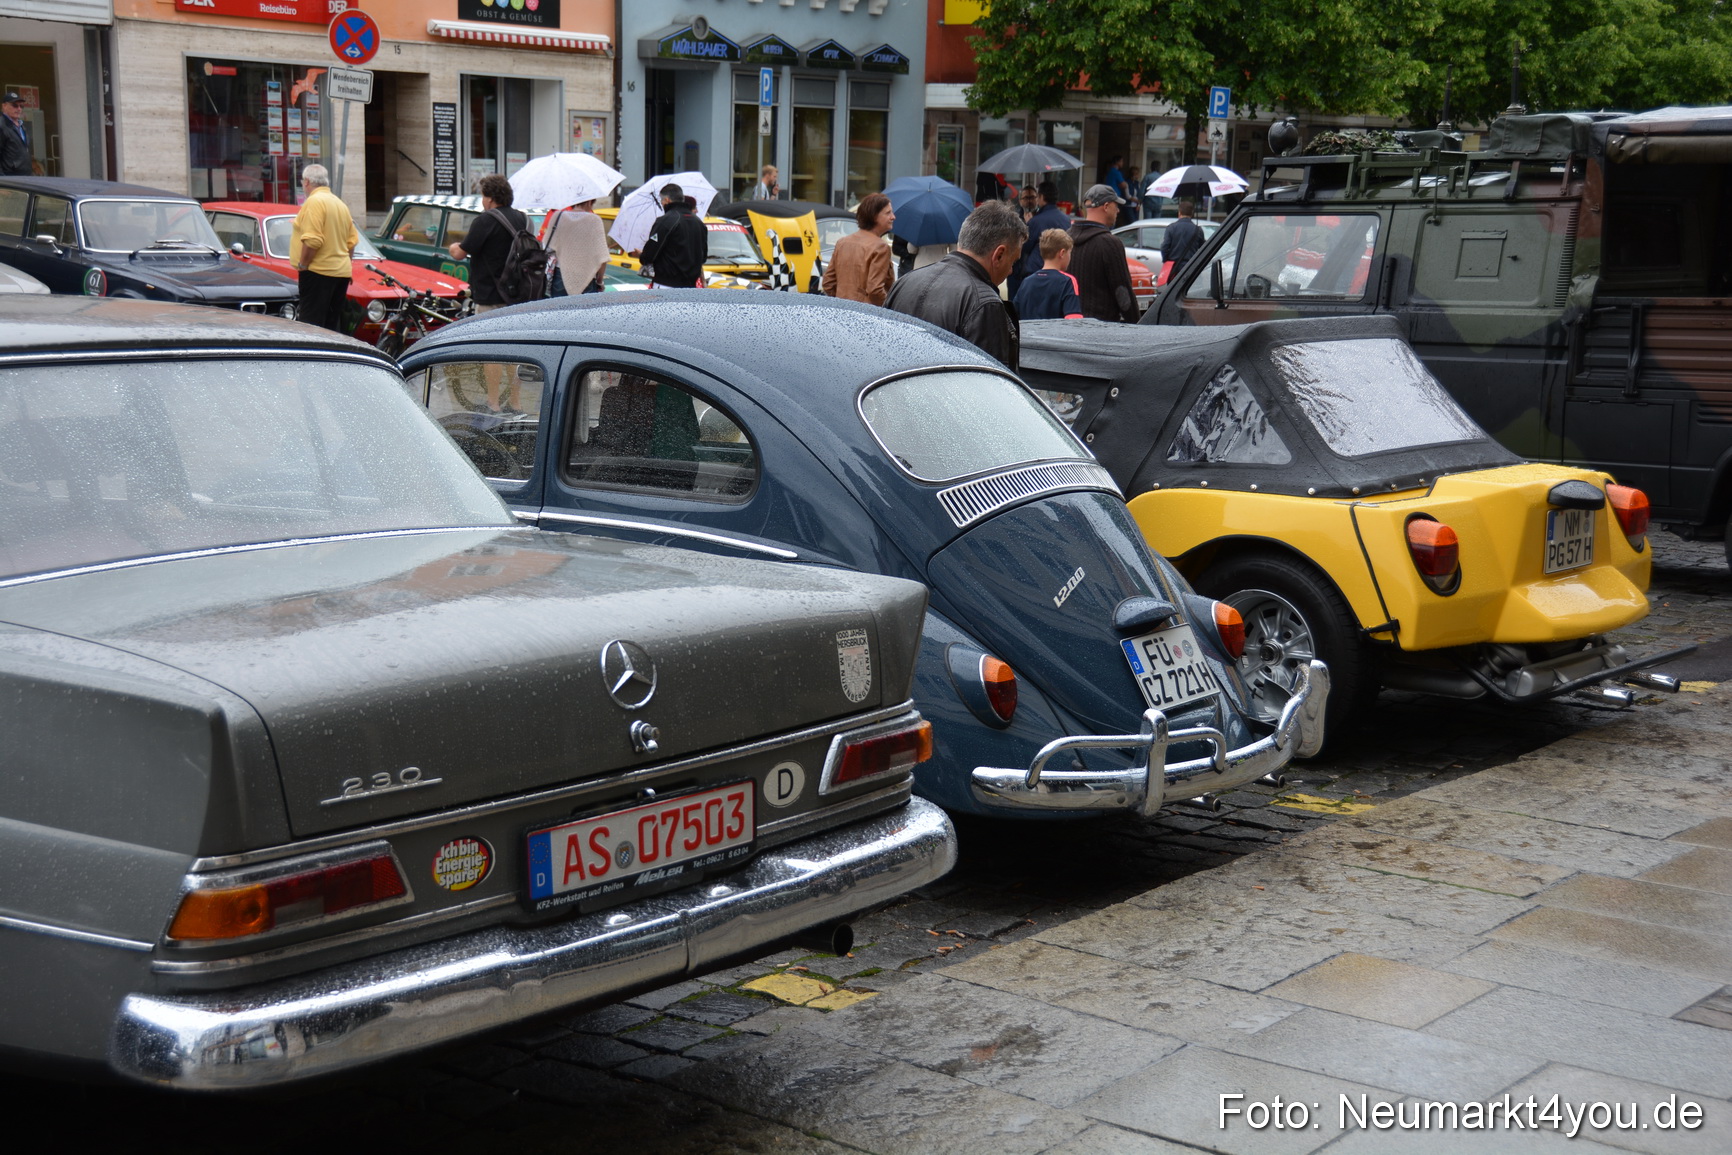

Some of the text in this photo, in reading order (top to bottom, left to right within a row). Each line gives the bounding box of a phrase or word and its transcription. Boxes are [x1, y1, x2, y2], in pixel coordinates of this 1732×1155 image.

[259, 3, 298, 16] Reisebüro
[328, 0, 348, 14] DER
[476, 9, 543, 23] OBST & GEMÜSE
[394, 44, 401, 55] 15
[671, 39, 728, 58] MÜHLBAUER
[332, 72, 370, 85] Wendebereich
[627, 81, 636, 93] 16
[337, 84, 363, 95] freihalten
[1213, 91, 1226, 115] P
[706, 224, 738, 233] BARTH
[89, 272, 102, 288] 61
[1564, 511, 1580, 538] NM
[1548, 542, 1565, 569] PG
[1053, 566, 1086, 609] 1200
[1142, 673, 1174, 707] CZ
[342, 766, 422, 798] 230
[778, 768, 794, 800] D
[440, 838, 479, 860] Ich bin
[563, 791, 745, 886] AS 07503
[435, 853, 487, 874] Energie-
[439, 868, 480, 890] sparer
[536, 872, 546, 888] D
[536, 882, 625, 910] KFZ-Werkstatt und Reifen
